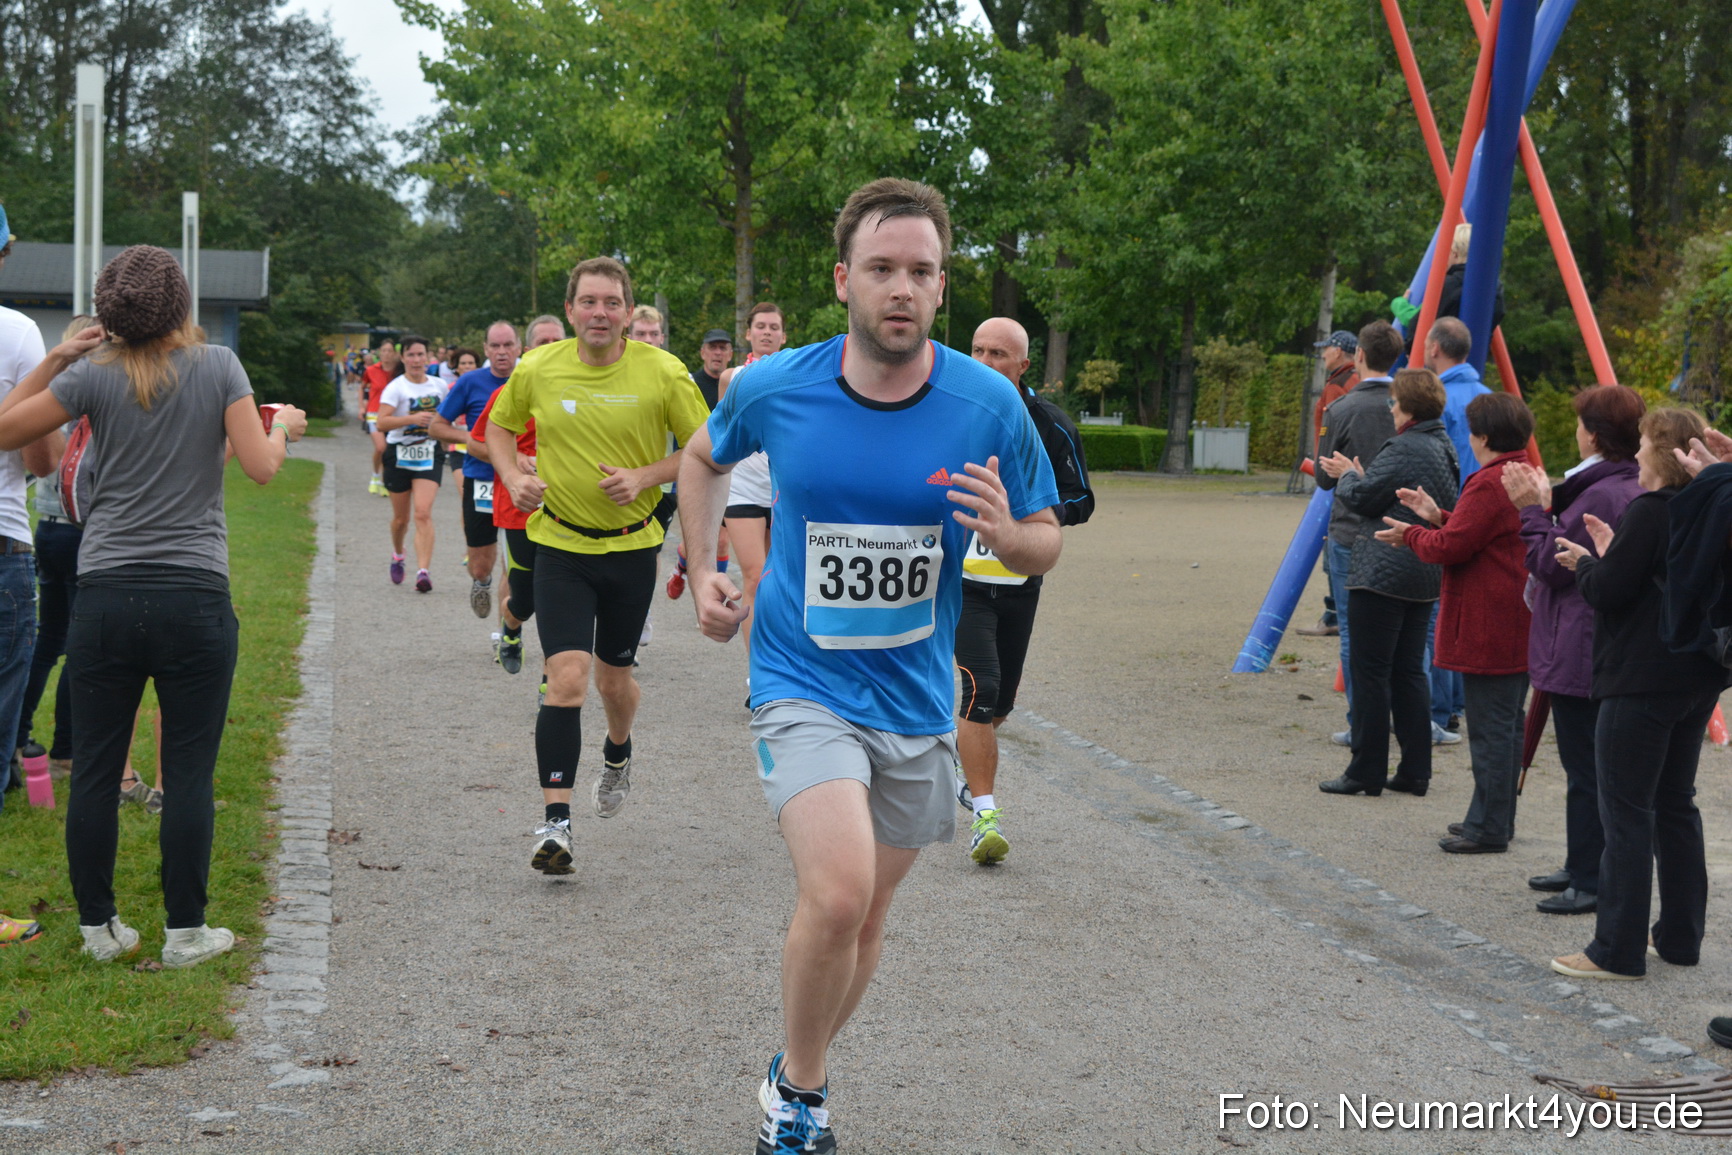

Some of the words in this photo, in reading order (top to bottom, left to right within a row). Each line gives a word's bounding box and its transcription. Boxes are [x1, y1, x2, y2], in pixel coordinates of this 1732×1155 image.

[402, 446, 430, 459] 2061
[809, 534, 853, 548] PARTL
[857, 538, 918, 550] Neumarkt
[819, 555, 931, 602] 3386
